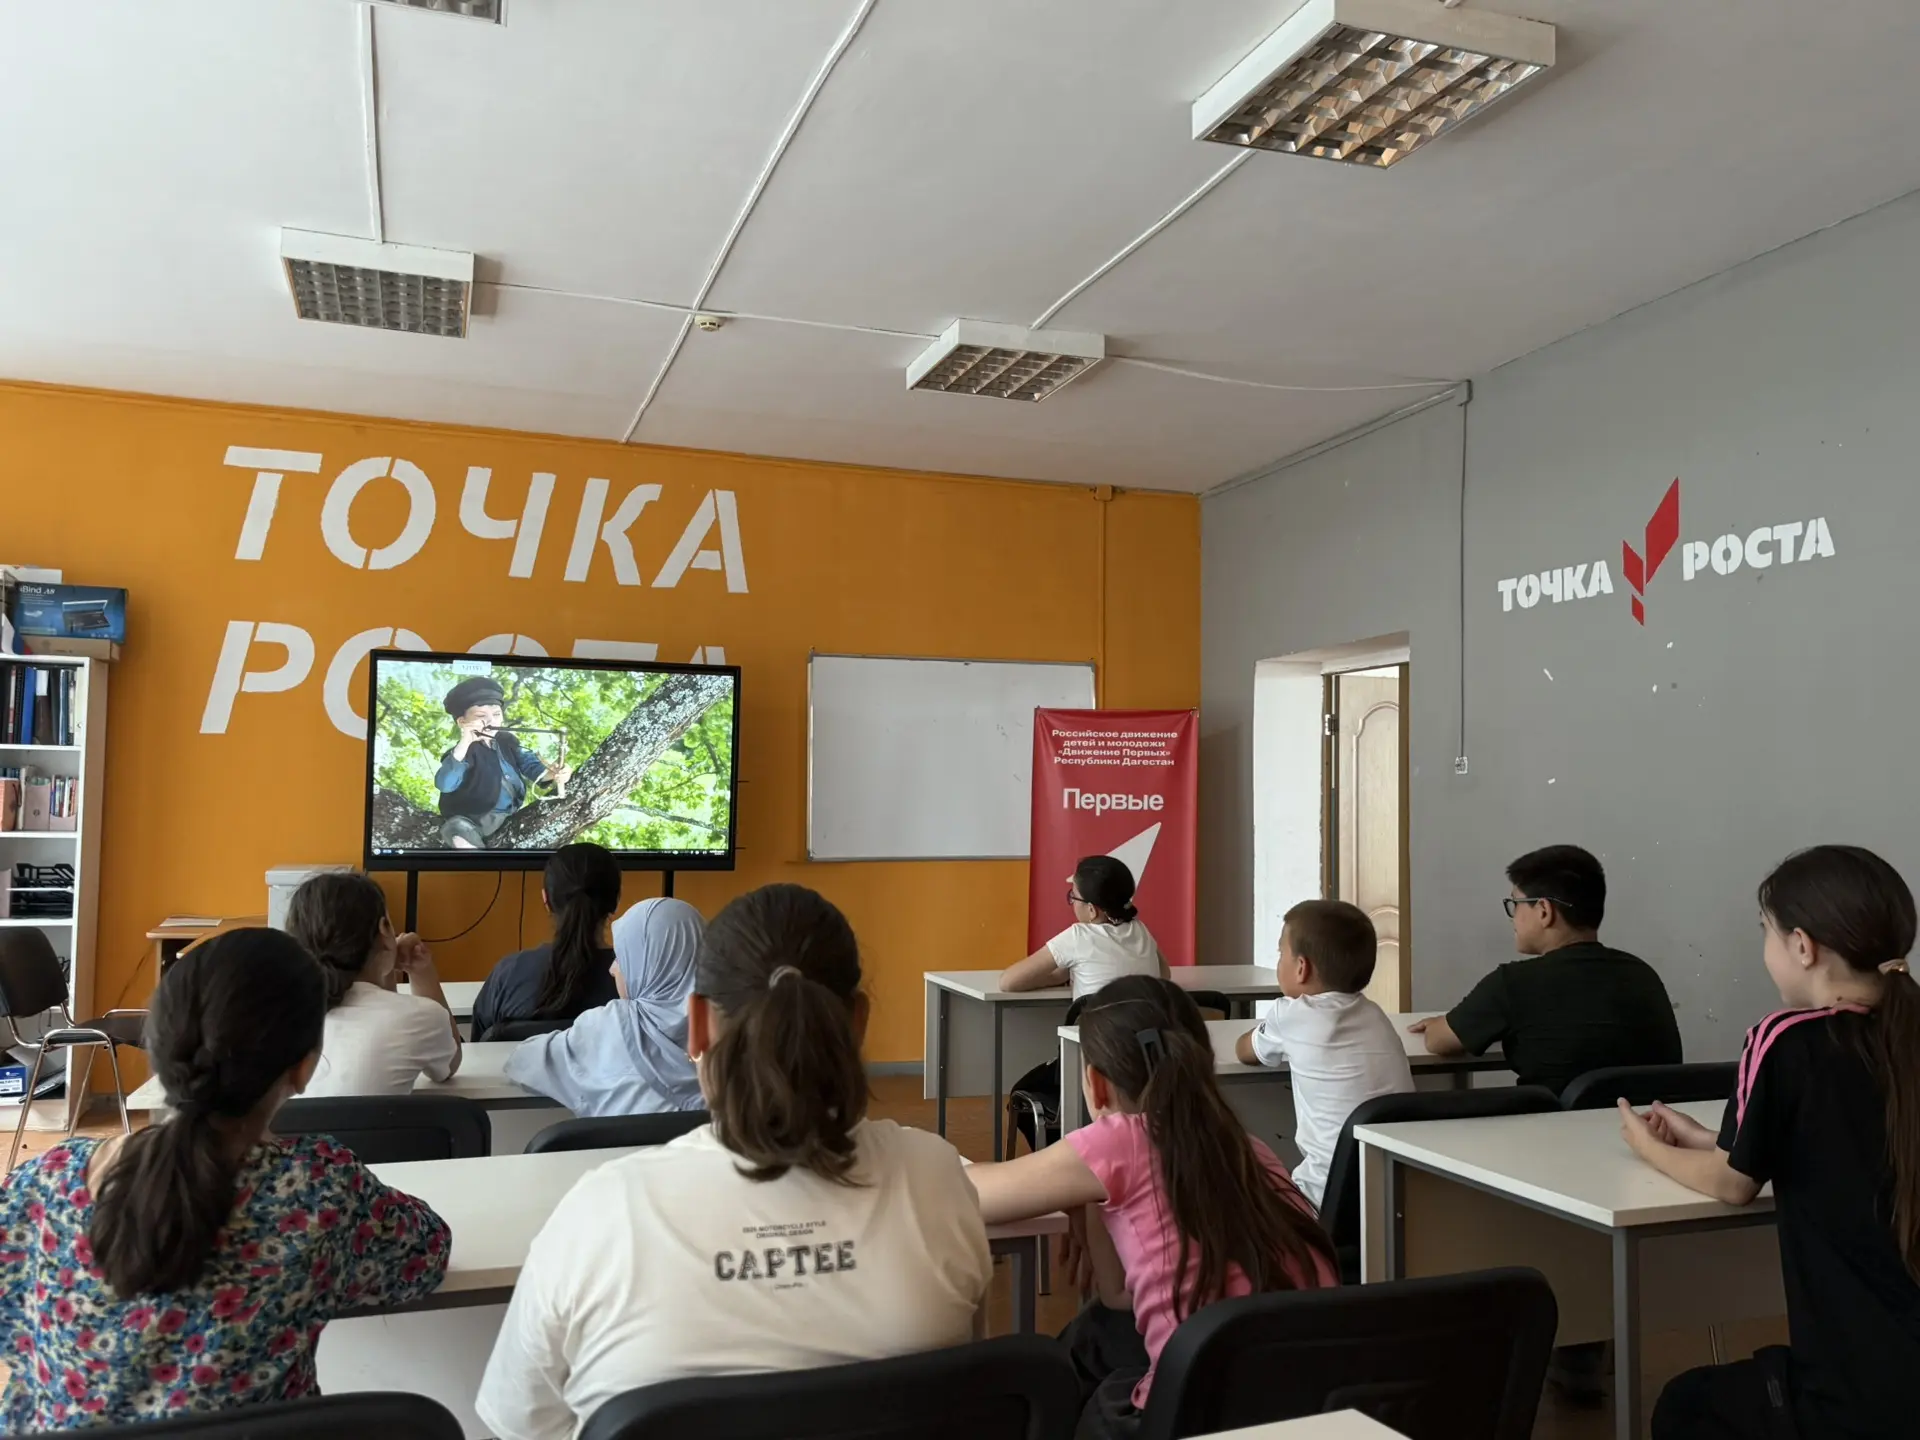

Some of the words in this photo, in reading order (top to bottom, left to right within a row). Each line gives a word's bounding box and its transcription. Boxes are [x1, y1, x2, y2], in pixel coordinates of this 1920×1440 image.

[223, 445, 749, 593] ТОЧКА
[1497, 560, 1614, 612] ТОЧКА
[1682, 517, 1835, 581] РОСТА
[1052, 729, 1118, 738] Российское
[1120, 731, 1178, 739] движение
[1063, 739, 1096, 747] детей
[1054, 756, 1120, 766] Республики
[1122, 757, 1175, 766] Дагестан
[1058, 748, 1120, 756] «Движение
[1122, 748, 1171, 757] Первых»
[1062, 788, 1164, 816] Первые
[714, 1239, 857, 1282] CAPTEE
